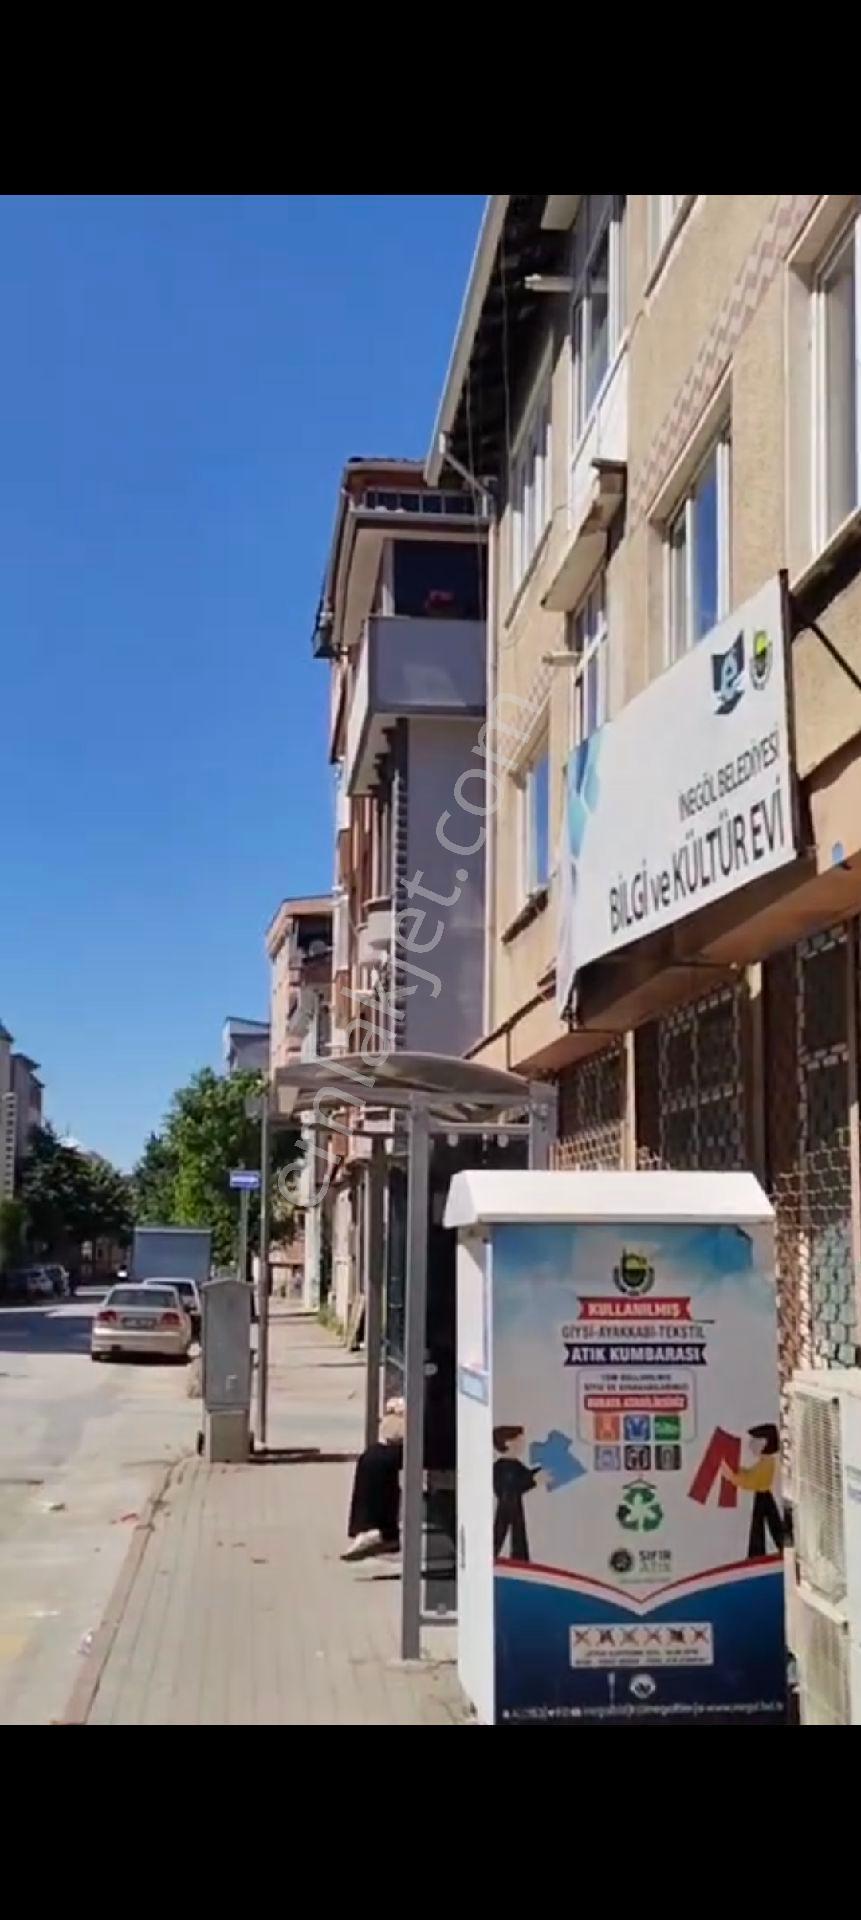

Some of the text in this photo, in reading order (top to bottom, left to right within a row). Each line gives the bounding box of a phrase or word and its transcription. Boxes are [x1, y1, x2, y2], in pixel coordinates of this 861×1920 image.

[678, 722, 779, 821] İNEGÖL BELEDİYESİ
[609, 774, 785, 934] BİLGİ ve KÜLTÜR EVİ
[587, 1303, 682, 1319] KULLANILMIŞ
[570, 1347, 700, 1362] ATIK KUMBARASI
